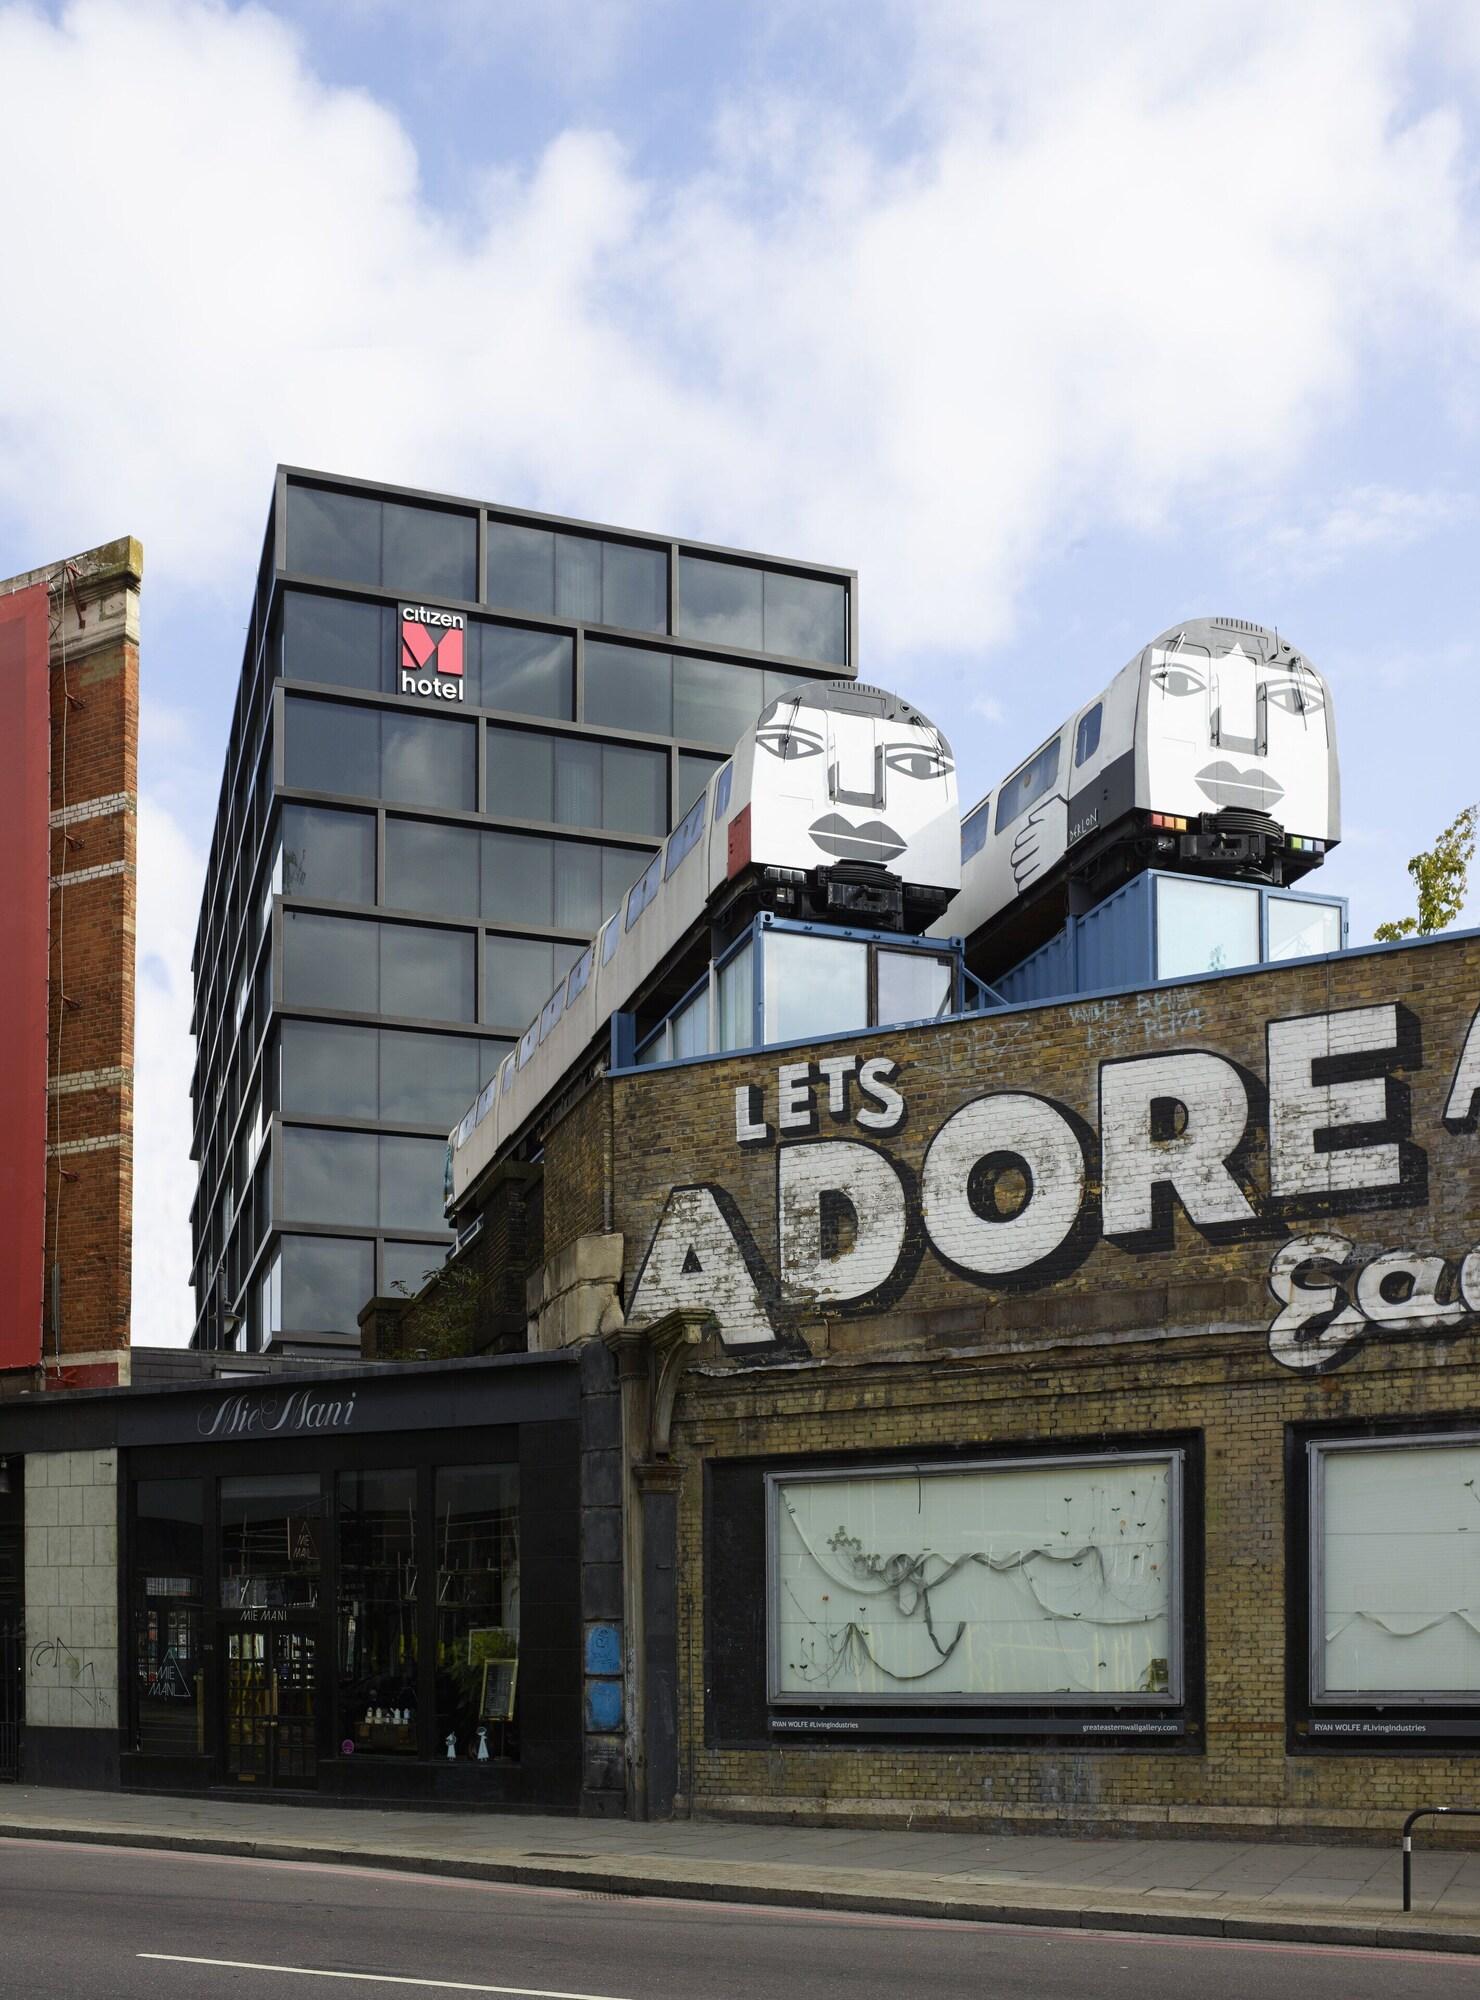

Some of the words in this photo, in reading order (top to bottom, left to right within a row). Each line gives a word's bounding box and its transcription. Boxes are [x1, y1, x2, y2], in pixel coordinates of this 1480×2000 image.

[402, 606, 464, 628] citizen
[401, 670, 464, 701] hotel
[735, 1056, 905, 1145] LETS
[623, 1003, 1408, 1350] ADORE
[198, 1395, 262, 1436] Mie
[260, 1389, 357, 1432] Mani
[240, 1609, 259, 1621] MIE
[260, 1609, 287, 1621] MANI
[772, 1720, 787, 1728] RYAN
[788, 1720, 808, 1729] WOLFE
[809, 1720, 859, 1730] #LivingIndustries
[1082, 1723, 1178, 1733] greateasternwallgallery.com
[1314, 1723, 1333, 1732] RYAN
[1335, 1723, 1361, 1732] WOLFE
[1362, 1723, 1427, 1733] #LivingIndustries
